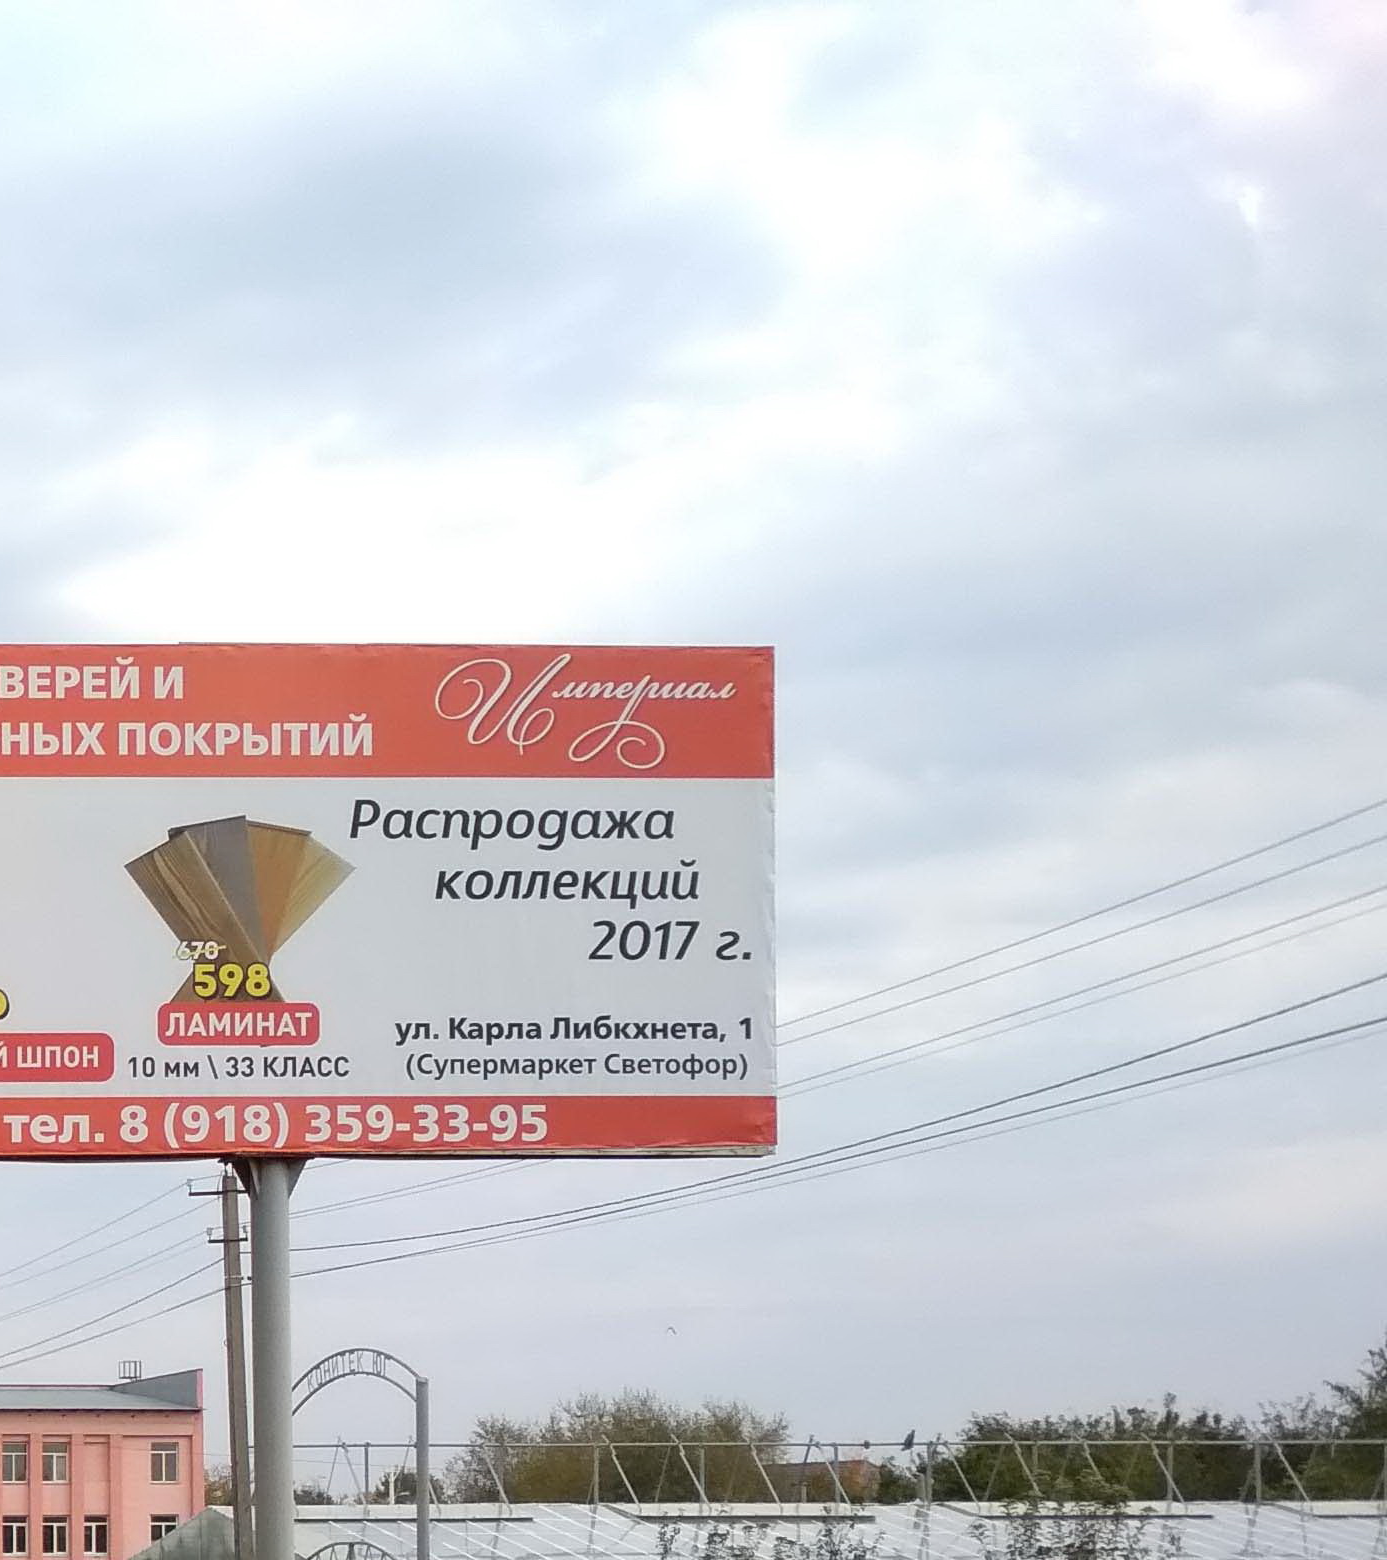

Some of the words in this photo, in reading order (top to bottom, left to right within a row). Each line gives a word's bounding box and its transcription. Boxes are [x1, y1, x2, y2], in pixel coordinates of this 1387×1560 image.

[154, 665, 185, 699] И
[434, 652, 737, 770] Империал
[117, 712, 374, 757] ПОКРЫТИЙ
[349, 799, 675, 851] Распродажа
[434, 858, 700, 910] коллекций
[588, 920, 700, 961] 2017
[715, 930, 753, 961] г.
[192, 962, 272, 1000] 598
[164, 1011, 314, 1038] ЛАМИНАТ
[394, 1022, 440, 1047] ул.
[447, 1017, 543, 1047] Карла
[549, 1015, 727, 1043] Либкхнета,
[738, 1017, 753, 1040] 1
[16, 1044, 100, 1069] ШПОН
[128, 1056, 156, 1078] 10
[164, 1061, 200, 1078] мм
[225, 1056, 255, 1078] 33
[262, 1056, 350, 1078] КЛАСС
[405, 1053, 597, 1081] (Супермаркет
[604, 1053, 749, 1081] Светофор)
[3, 1112, 105, 1144] тел.
[119, 1105, 149, 1144] 8
[163, 1102, 289, 1149] (918)
[305, 1104, 548, 1143] 359-33-95
